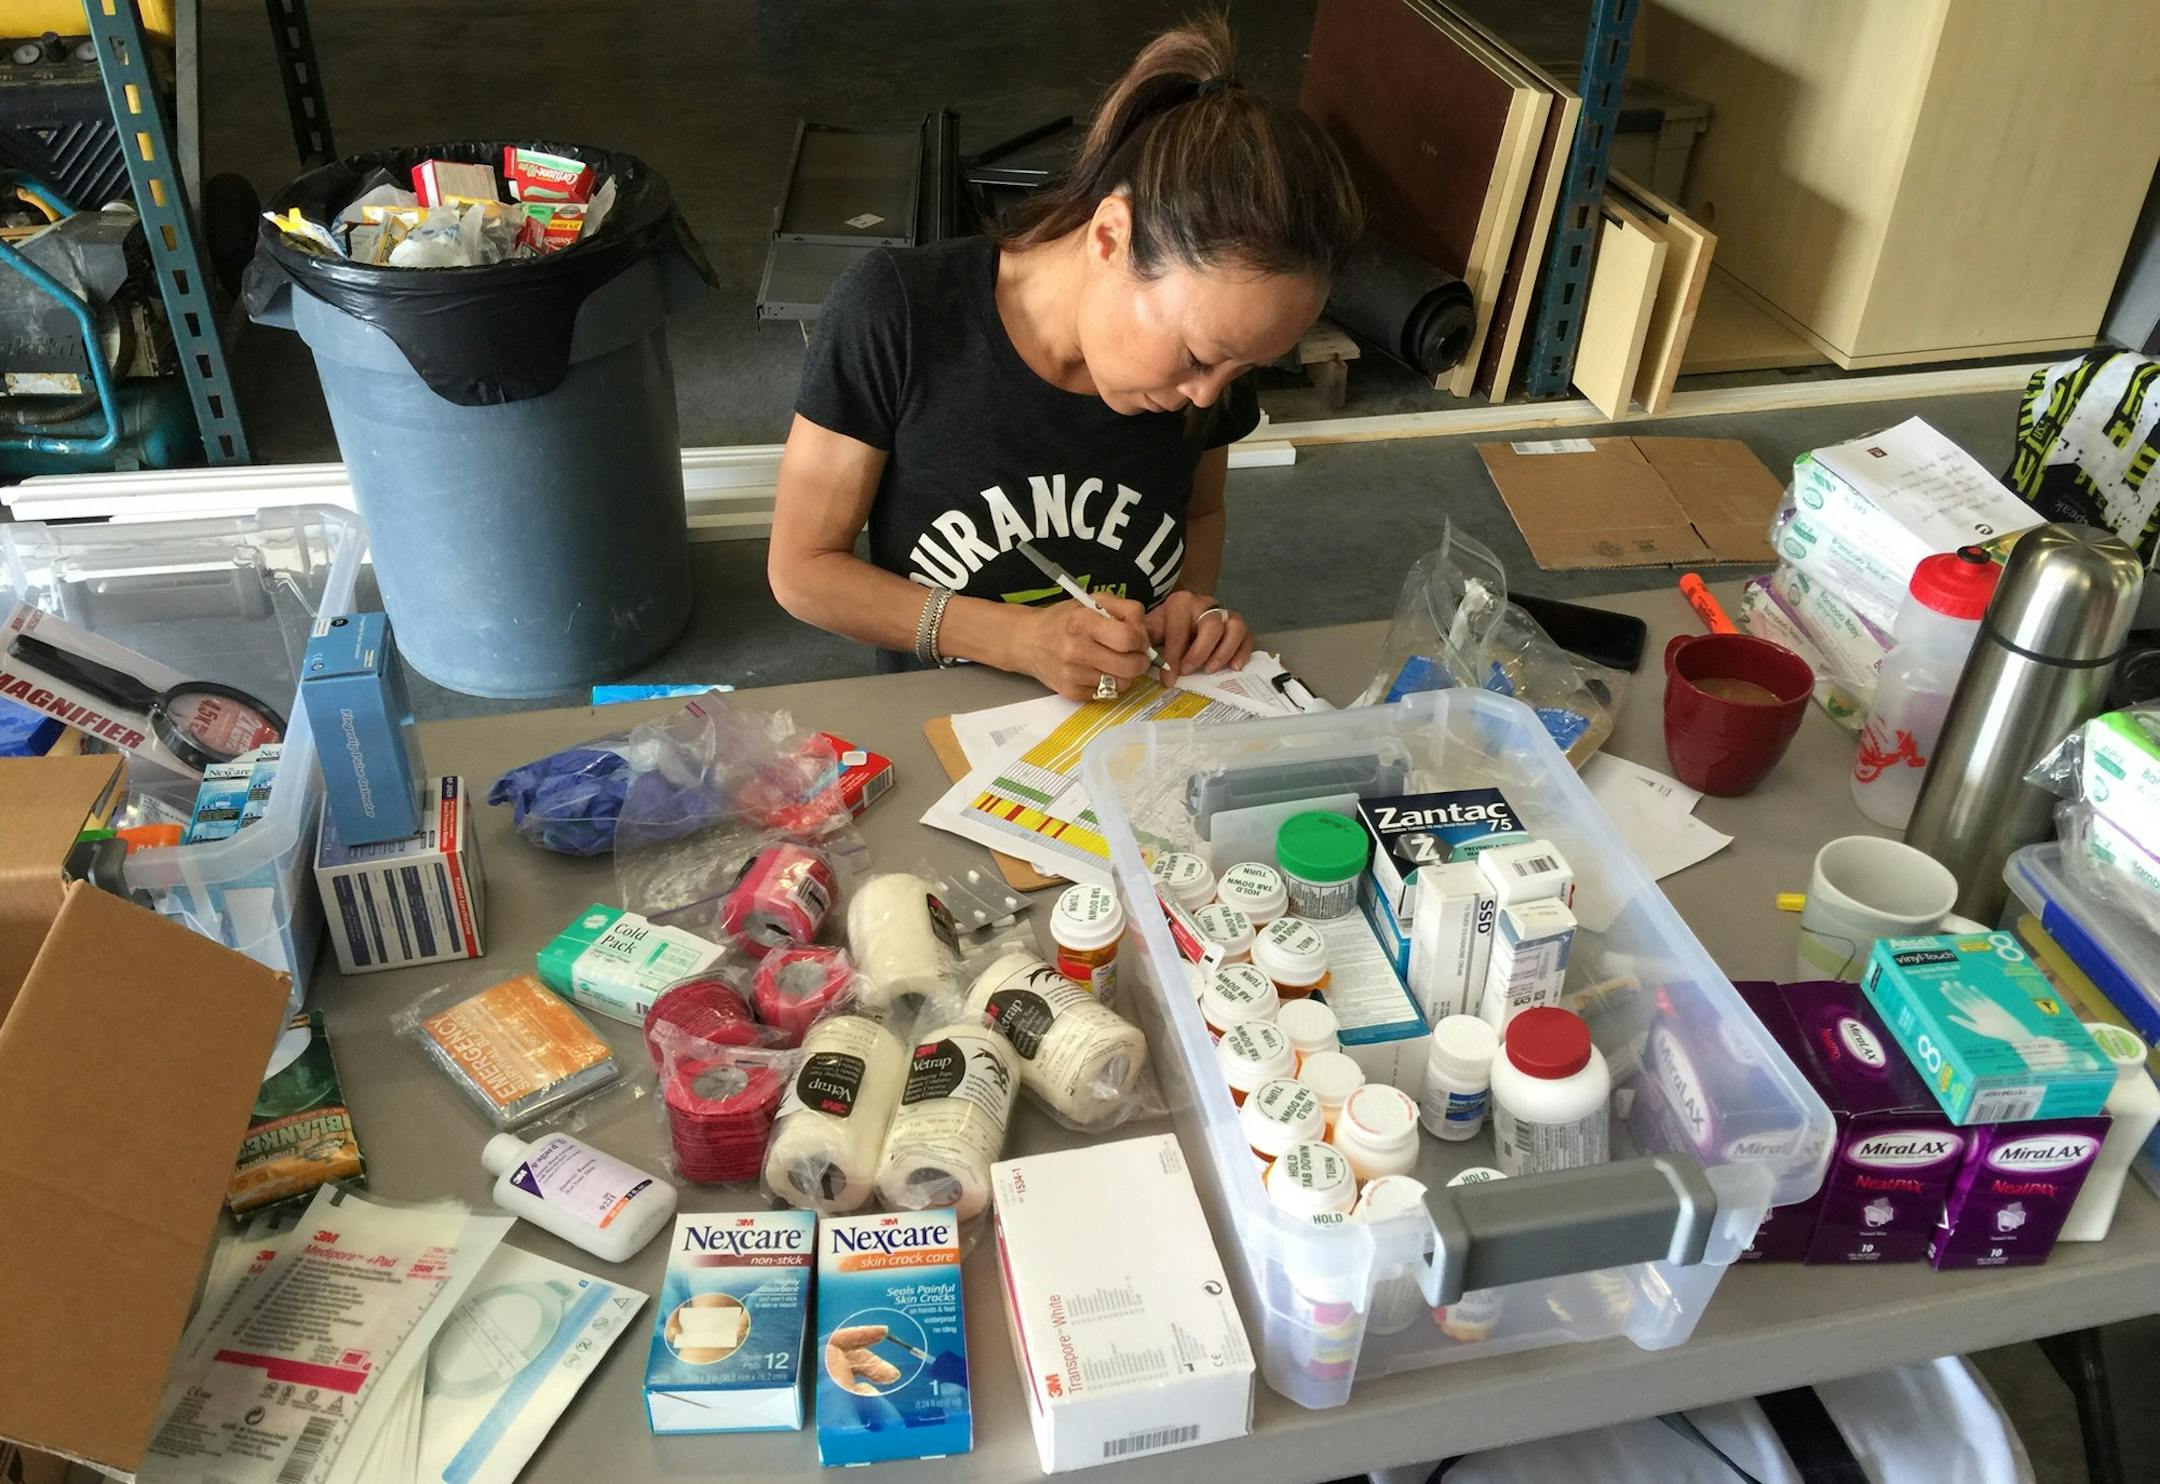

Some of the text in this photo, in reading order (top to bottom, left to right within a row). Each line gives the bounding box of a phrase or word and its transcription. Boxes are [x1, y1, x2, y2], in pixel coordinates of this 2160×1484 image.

[208, 767, 251, 779] Nexcare
[1374, 802, 1513, 832] Zantac 75
[1410, 837, 1442, 863] Z
[1184, 862, 1196, 876] TURN
[1243, 867, 1267, 877] TURN
[1228, 877, 1273, 892] TAB DOWN
[1235, 887, 1260, 896] HOLD
[1068, 894, 1079, 912] TURN
[1088, 887, 1101, 920] TAB DOWN
[1101, 895, 1111, 912] HOLD
[1202, 914, 1216, 932] TURN
[1220, 905, 1239, 938] TAB DOWN
[1233, 912, 1248, 930] HOLD
[1477, 899, 1494, 934] SSD
[613, 923, 648, 942] Cold
[1270, 920, 1288, 934] HOLD
[1272, 920, 1303, 945] TAB DOWN
[599, 934, 638, 955] Pack
[1296, 936, 1314, 950] TURN
[1889, 936, 1938, 948] Ansell
[1216, 972, 1254, 1003] TAB DOWN
[1240, 970, 1262, 988] TURN
[1215, 984, 1238, 1002] HOLD
[1228, 1036, 1247, 1056] HOLD
[1234, 1025, 1262, 1062] TAB DOWN
[1261, 1028, 1278, 1048] TURN
[1846, 1021, 1880, 1065] MiraLAX
[430, 1016, 517, 1100] EMERGENCY
[913, 1055, 953, 1076] Vetrap
[486, 1052, 530, 1091] SURVIVAL
[807, 1077, 854, 1105] Vetrap
[1264, 1086, 1284, 1106] TURN
[1280, 1087, 1310, 1124] TAB DOWN
[1296, 1099, 1315, 1120] HOLD
[1860, 1141, 1949, 1157] MiraLAX
[2000, 1144, 2087, 1160] MiraLAX
[1287, 1154, 1299, 1178] HOLD
[1299, 1145, 1313, 1188] TAB DOWN
[1324, 1156, 1337, 1179] TURN
[511, 1168, 529, 1186] 3M
[1012, 1168, 1026, 1194] 1534-1
[1461, 1170, 1491, 1186] HOLD
[598, 1193, 618, 1212] 9221
[736, 1218, 755, 1227] 3M
[880, 1217, 899, 1226] 3M
[1313, 1213, 1343, 1224] HOLD
[313, 1229, 341, 1244] 3M
[682, 1225, 802, 1257] Nexcare
[832, 1223, 950, 1257] Nexcare
[1862, 1243, 1874, 1252] 10
[1990, 1248, 2003, 1257] 10
[751, 1255, 803, 1266] non-stick
[860, 1252, 954, 1268] skin crack care
[886, 1283, 956, 1297] Seals Painful
[894, 1292, 956, 1305] Skin Cracks
[923, 1315, 957, 1325] waterproof
[1049, 1293, 1068, 1329] White
[765, 1351, 790, 1370] 12
[1058, 1335, 1083, 1396] Transpore
[929, 1379, 939, 1396] 1
[1045, 1373, 1063, 1398] 3M
